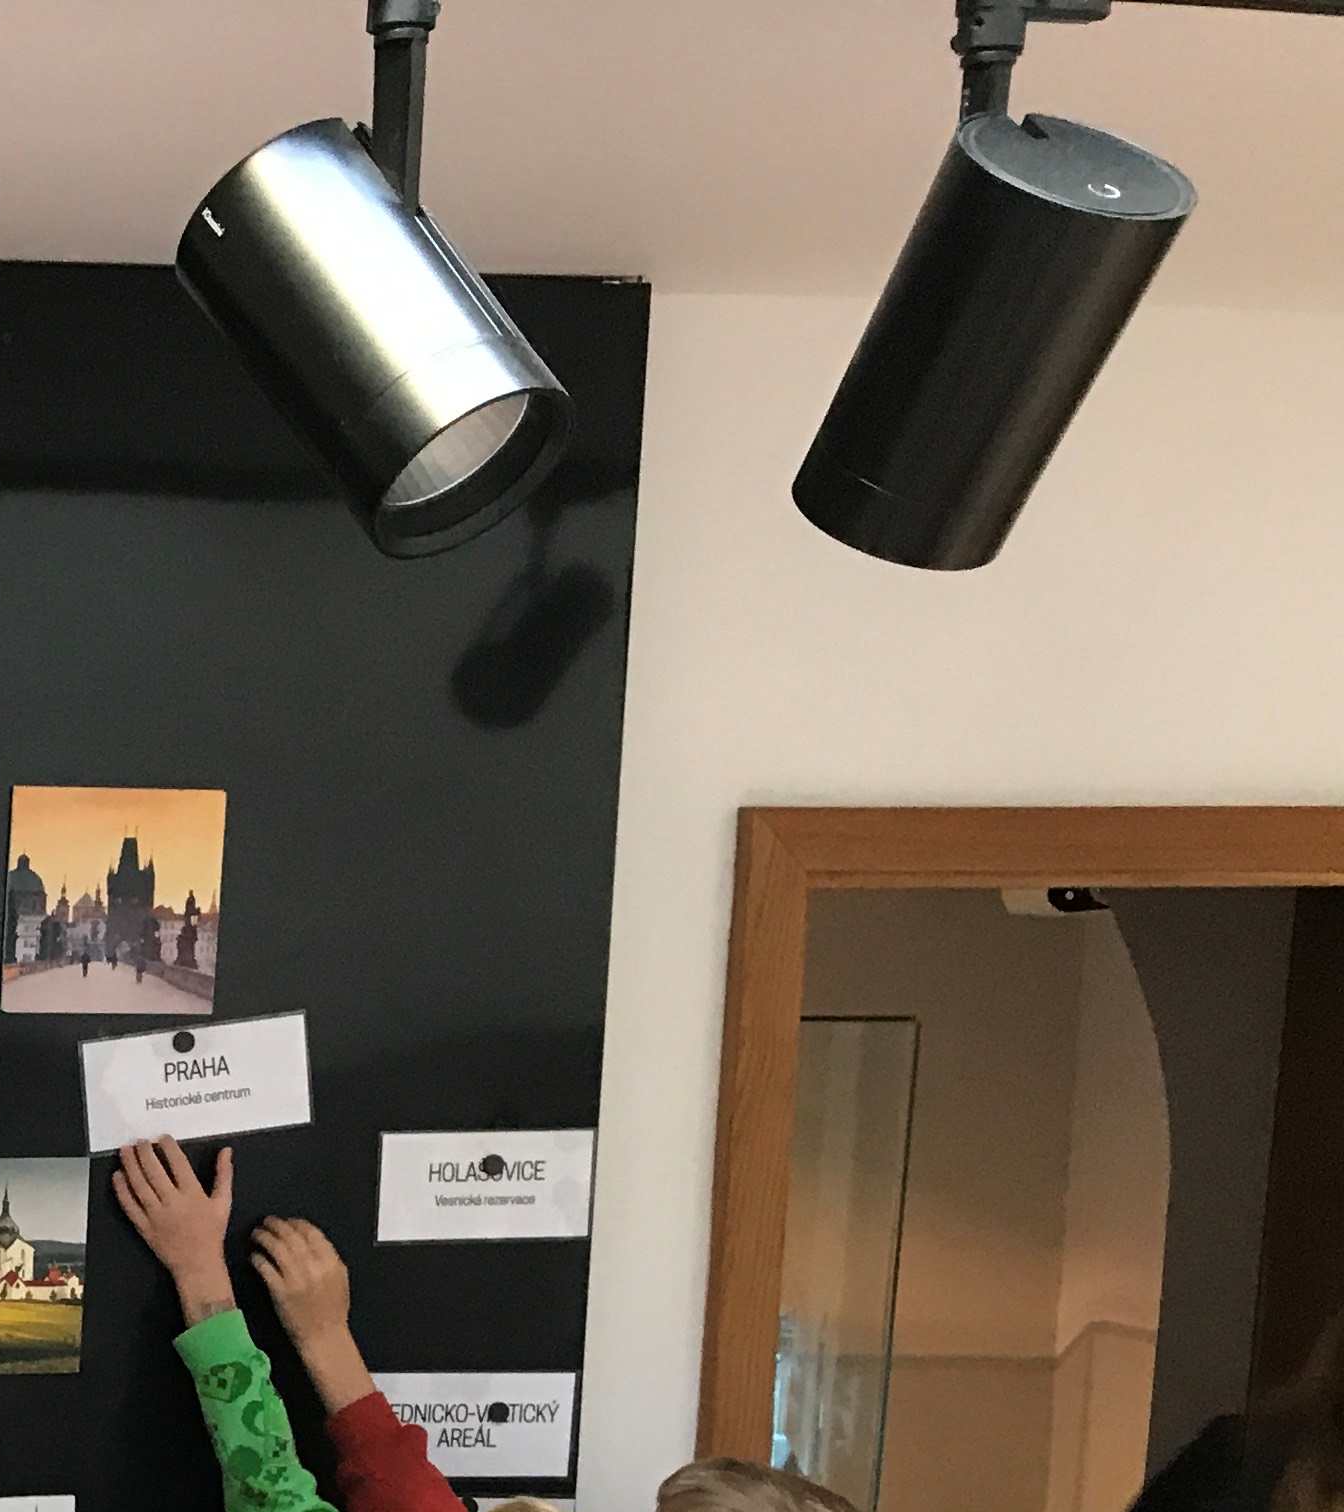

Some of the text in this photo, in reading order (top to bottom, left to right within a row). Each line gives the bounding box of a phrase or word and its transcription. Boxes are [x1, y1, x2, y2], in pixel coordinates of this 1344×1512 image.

[164, 1055, 230, 1083] PRAHA
[145, 1087, 251, 1111] Historické centrum
[484, 1194, 536, 1206] rezervace
[390, 1400, 560, 1424] DNICKO-VTICKÝ
[436, 1424, 497, 1448] AREÁL
